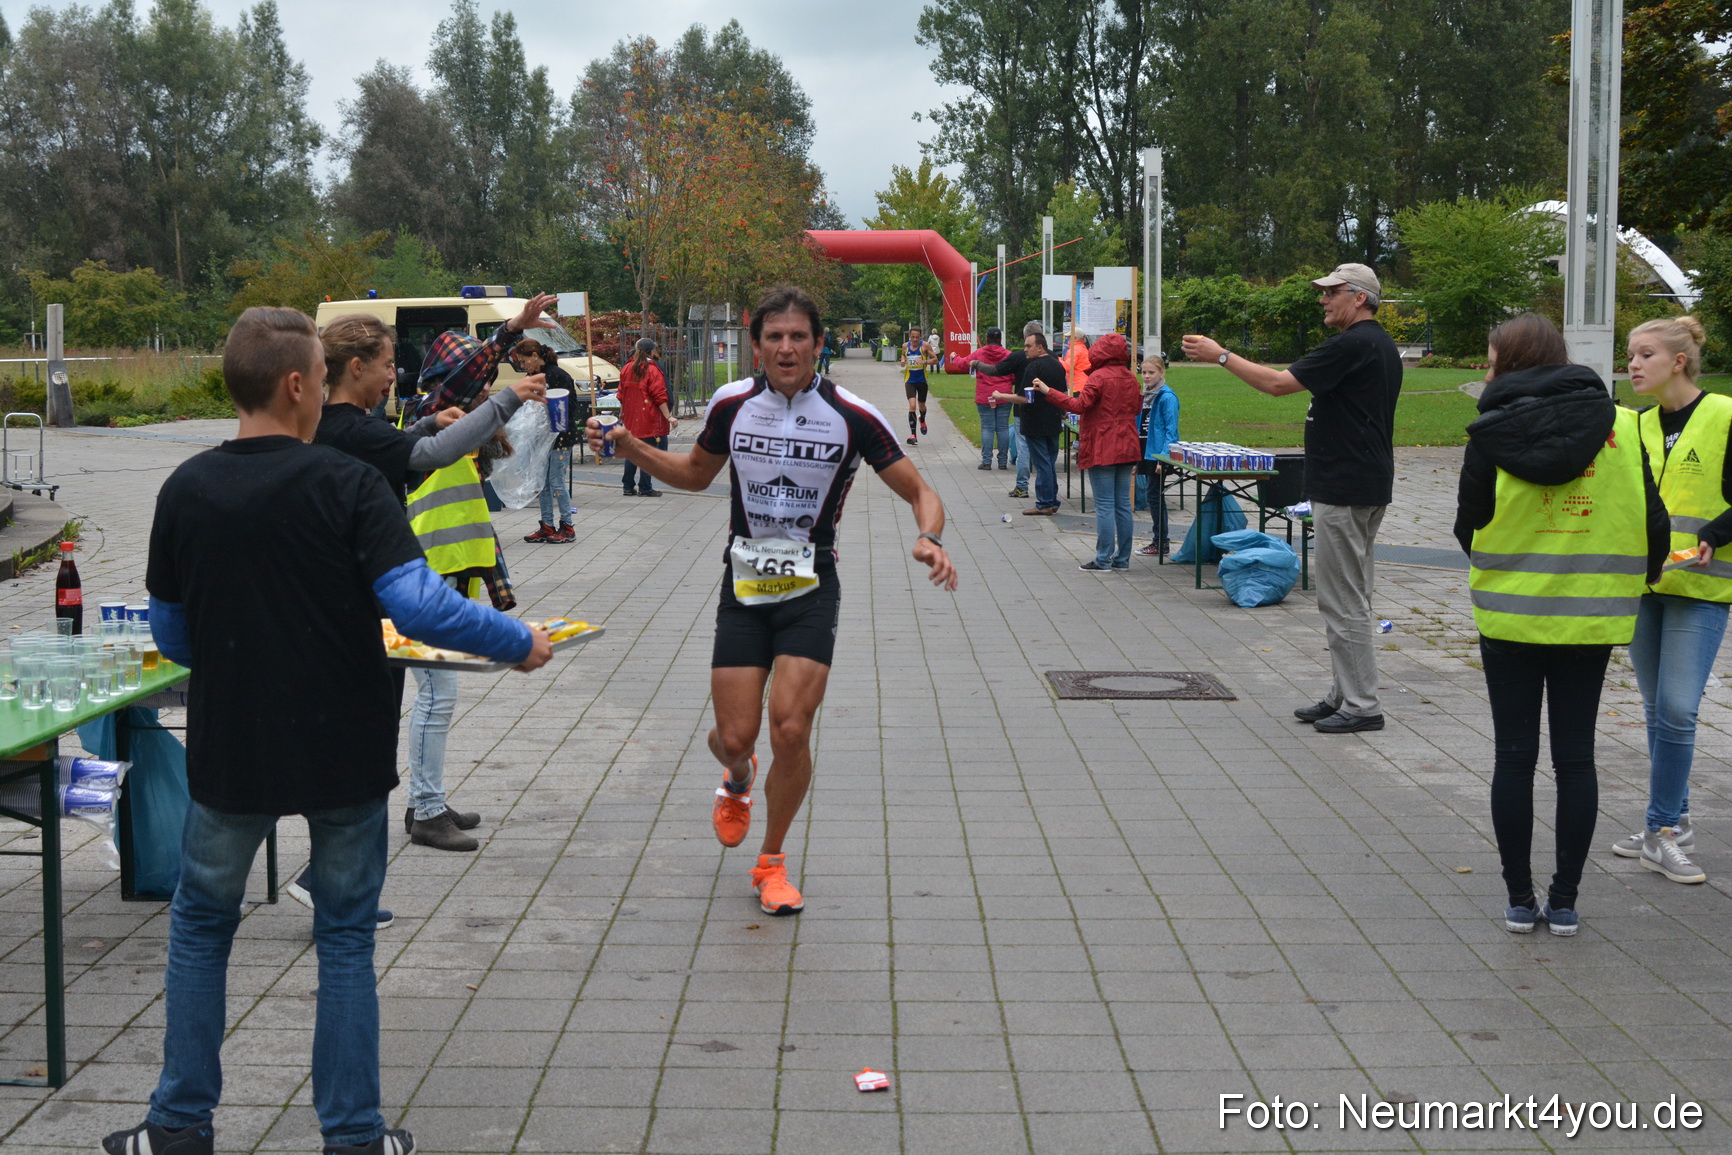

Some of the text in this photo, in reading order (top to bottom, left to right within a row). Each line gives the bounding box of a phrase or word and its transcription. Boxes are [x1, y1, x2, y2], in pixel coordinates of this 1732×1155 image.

[807, 419, 831, 427] ZURICH
[734, 434, 840, 460] POSITIV
[742, 454, 766, 463] FITNESS
[774, 459, 835, 470] WELLNESSGRUPPE
[747, 482, 818, 500] WOLFRUM
[747, 496, 817, 509] BAUUNTERNEHMEN
[762, 546, 799, 556] Neumarkt
[756, 581, 796, 592] Markus
